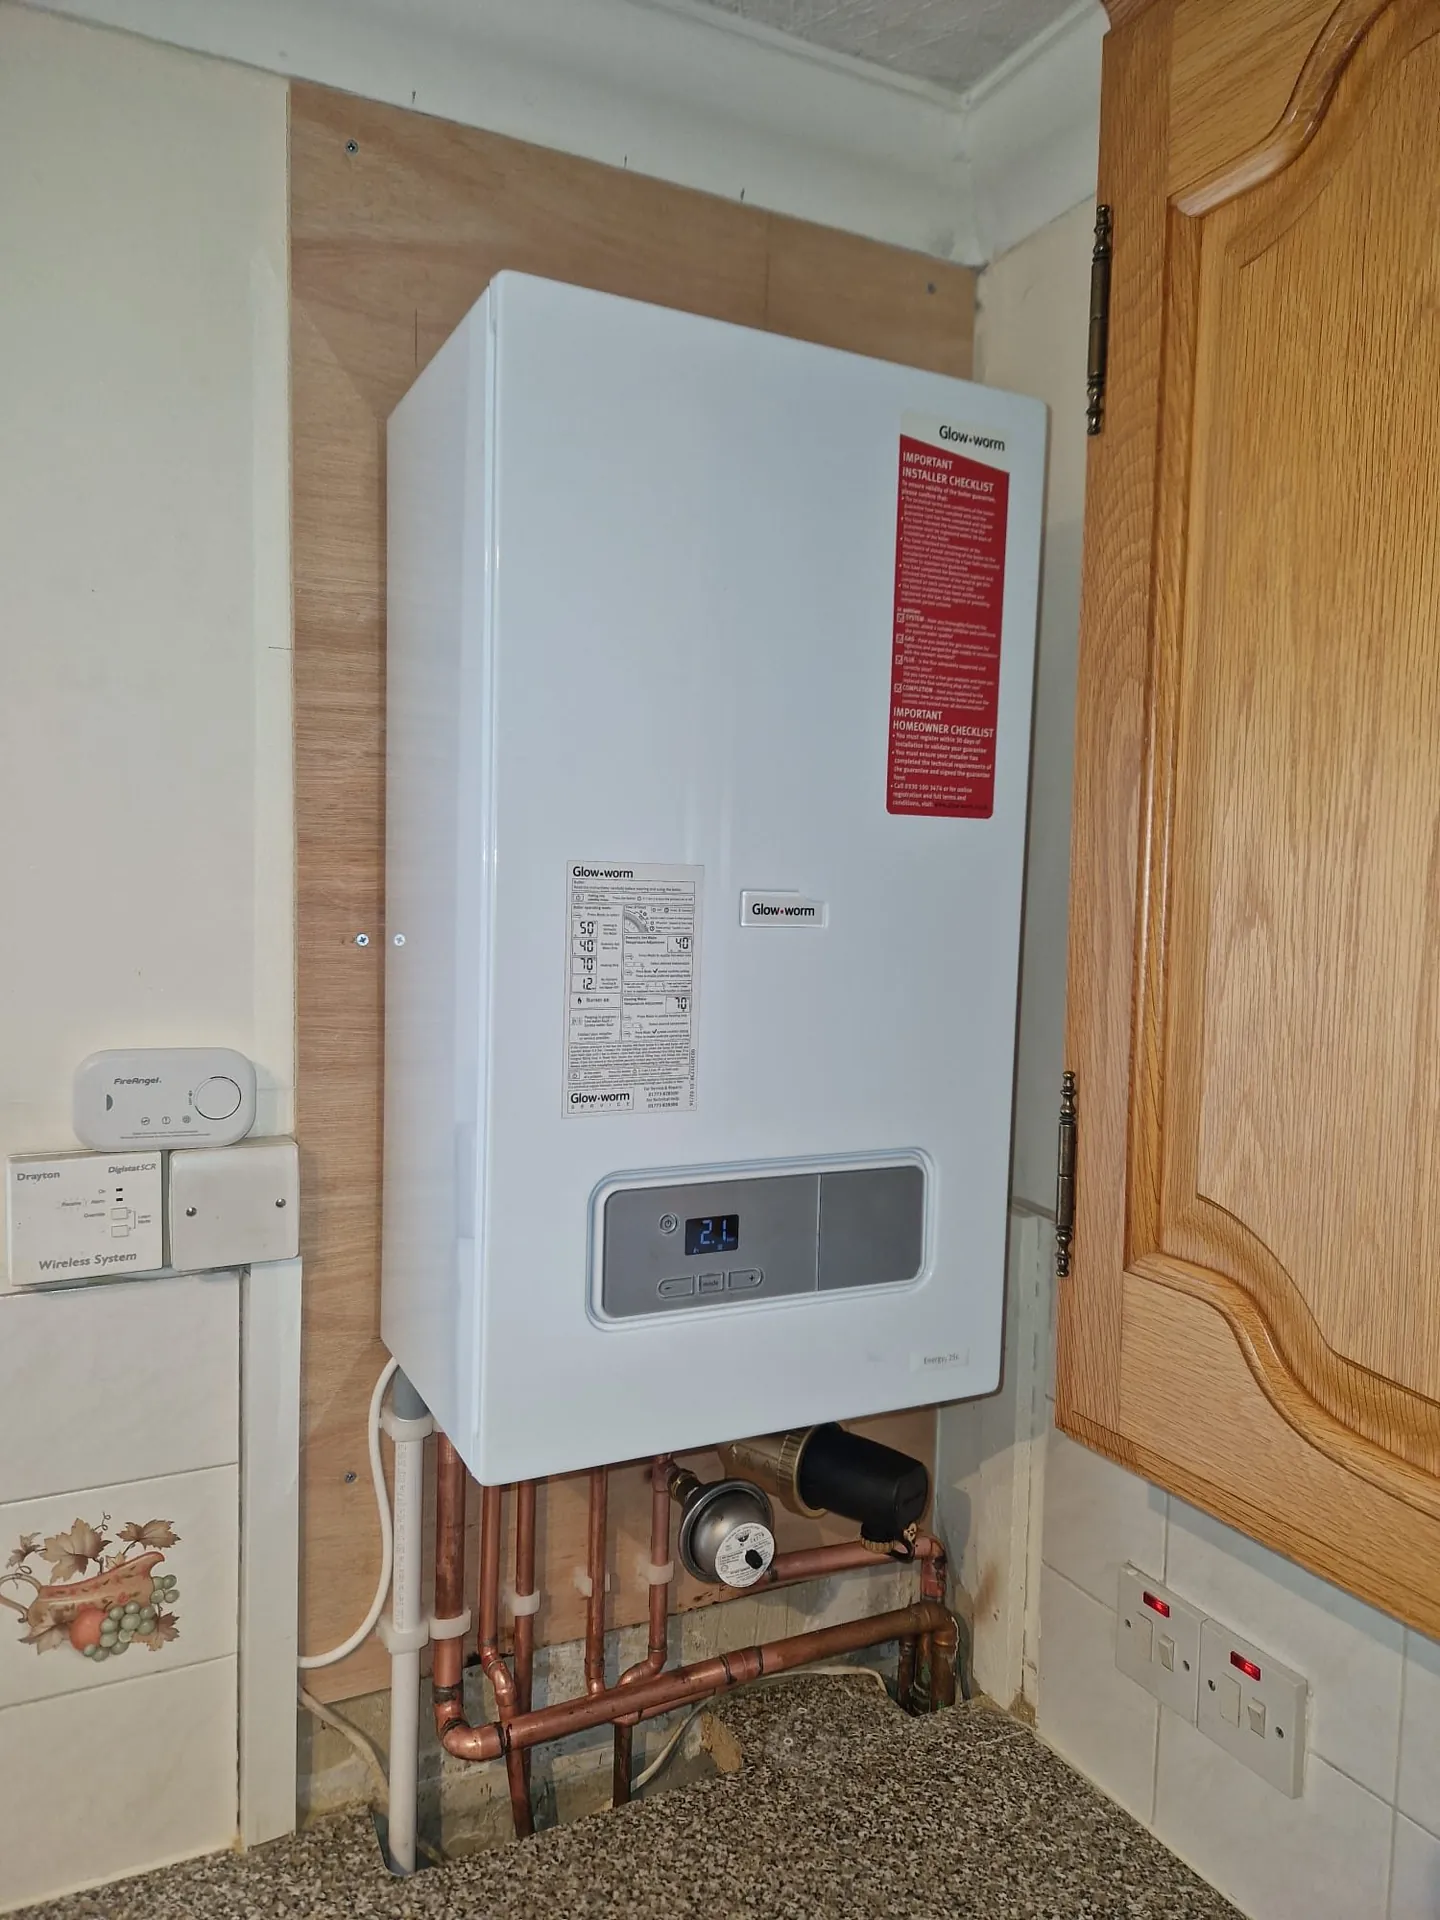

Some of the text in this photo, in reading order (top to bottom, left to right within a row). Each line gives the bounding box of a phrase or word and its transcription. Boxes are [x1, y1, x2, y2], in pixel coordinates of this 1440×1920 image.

[903, 452, 953, 470] IMPORTANT
[902, 467, 994, 493] INSTALLER CHECKLIST
[894, 707, 942, 721] IMPORTANT
[893, 720, 994, 738] HOMEOWNER CHECKLIST
[895, 741, 923, 749] installation
[580, 921, 594, 935] 50
[580, 940, 594, 952] 40
[676, 937, 689, 949] 40
[583, 977, 592, 990] 12
[17, 1171, 61, 1182] Drayton
[700, 1219, 727, 1245] 2.1
[39, 1252, 137, 1270] Wireless System
